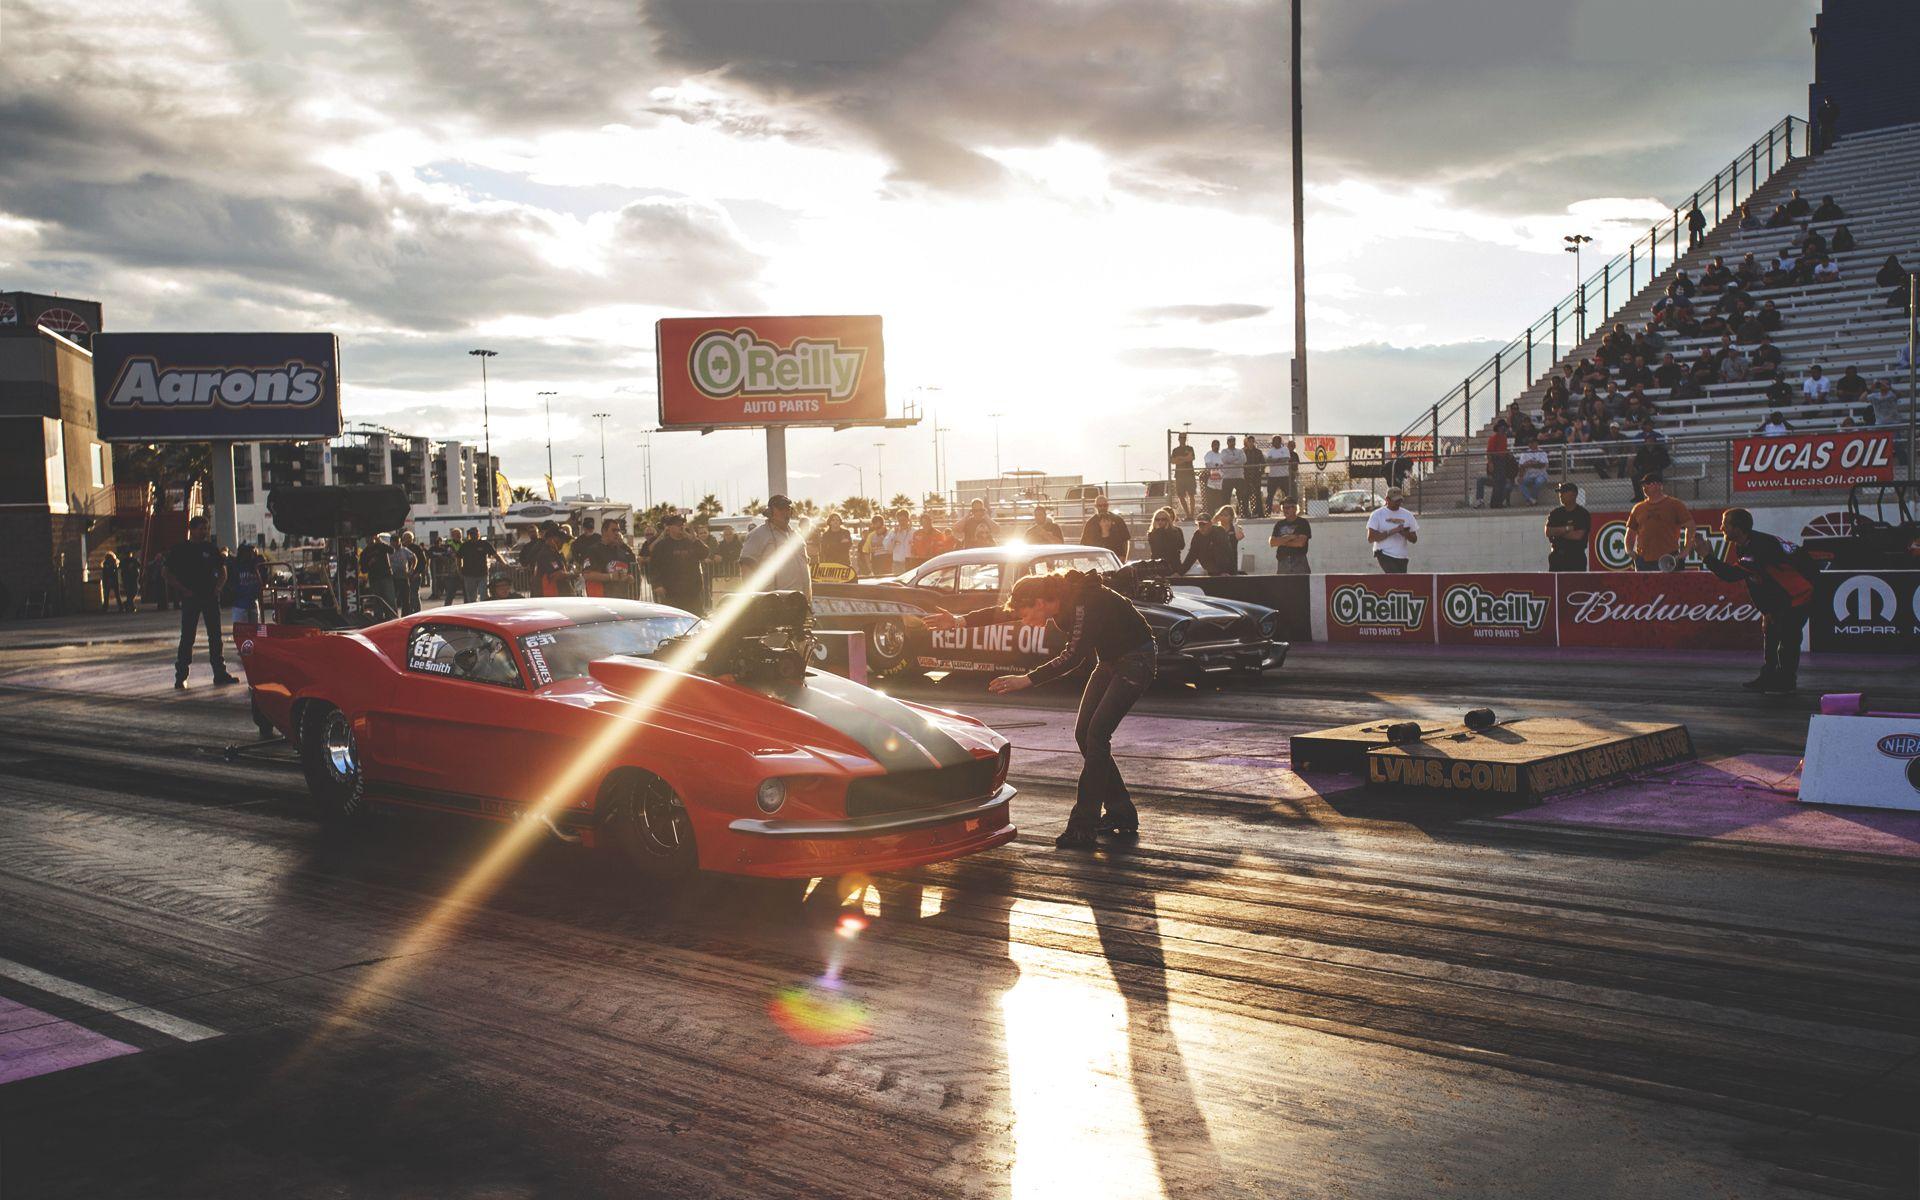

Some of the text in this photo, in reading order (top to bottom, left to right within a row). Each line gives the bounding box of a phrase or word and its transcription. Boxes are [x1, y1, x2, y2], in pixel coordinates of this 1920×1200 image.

[697, 337, 857, 393] O'Reilly
[112, 361, 321, 405] Aaron's
[743, 399, 820, 414] AUTO PARTS
[1351, 448, 1383, 460] ROSS
[1737, 438, 1889, 473] LUCAS OIL
[1746, 474, 1878, 488] www.LucasOil.com
[1334, 586, 1425, 628] O'Reilly
[1446, 586, 1544, 629] O'Reilly
[931, 628, 968, 649] RED
[972, 624, 1013, 652] LINE
[1018, 625, 1050, 654] OIL
[1359, 627, 1401, 636] AUTO PARTS
[1473, 629, 1520, 638] AUTO PARTS
[1834, 626, 1896, 634] MOPAR
[414, 640, 439, 659] 631
[410, 657, 451, 674] Lee Smith
[531, 648, 553, 683] HUGHES
[1368, 756, 1518, 793] LVMS.COM
[1583, 744, 1637, 780] GREATEST
